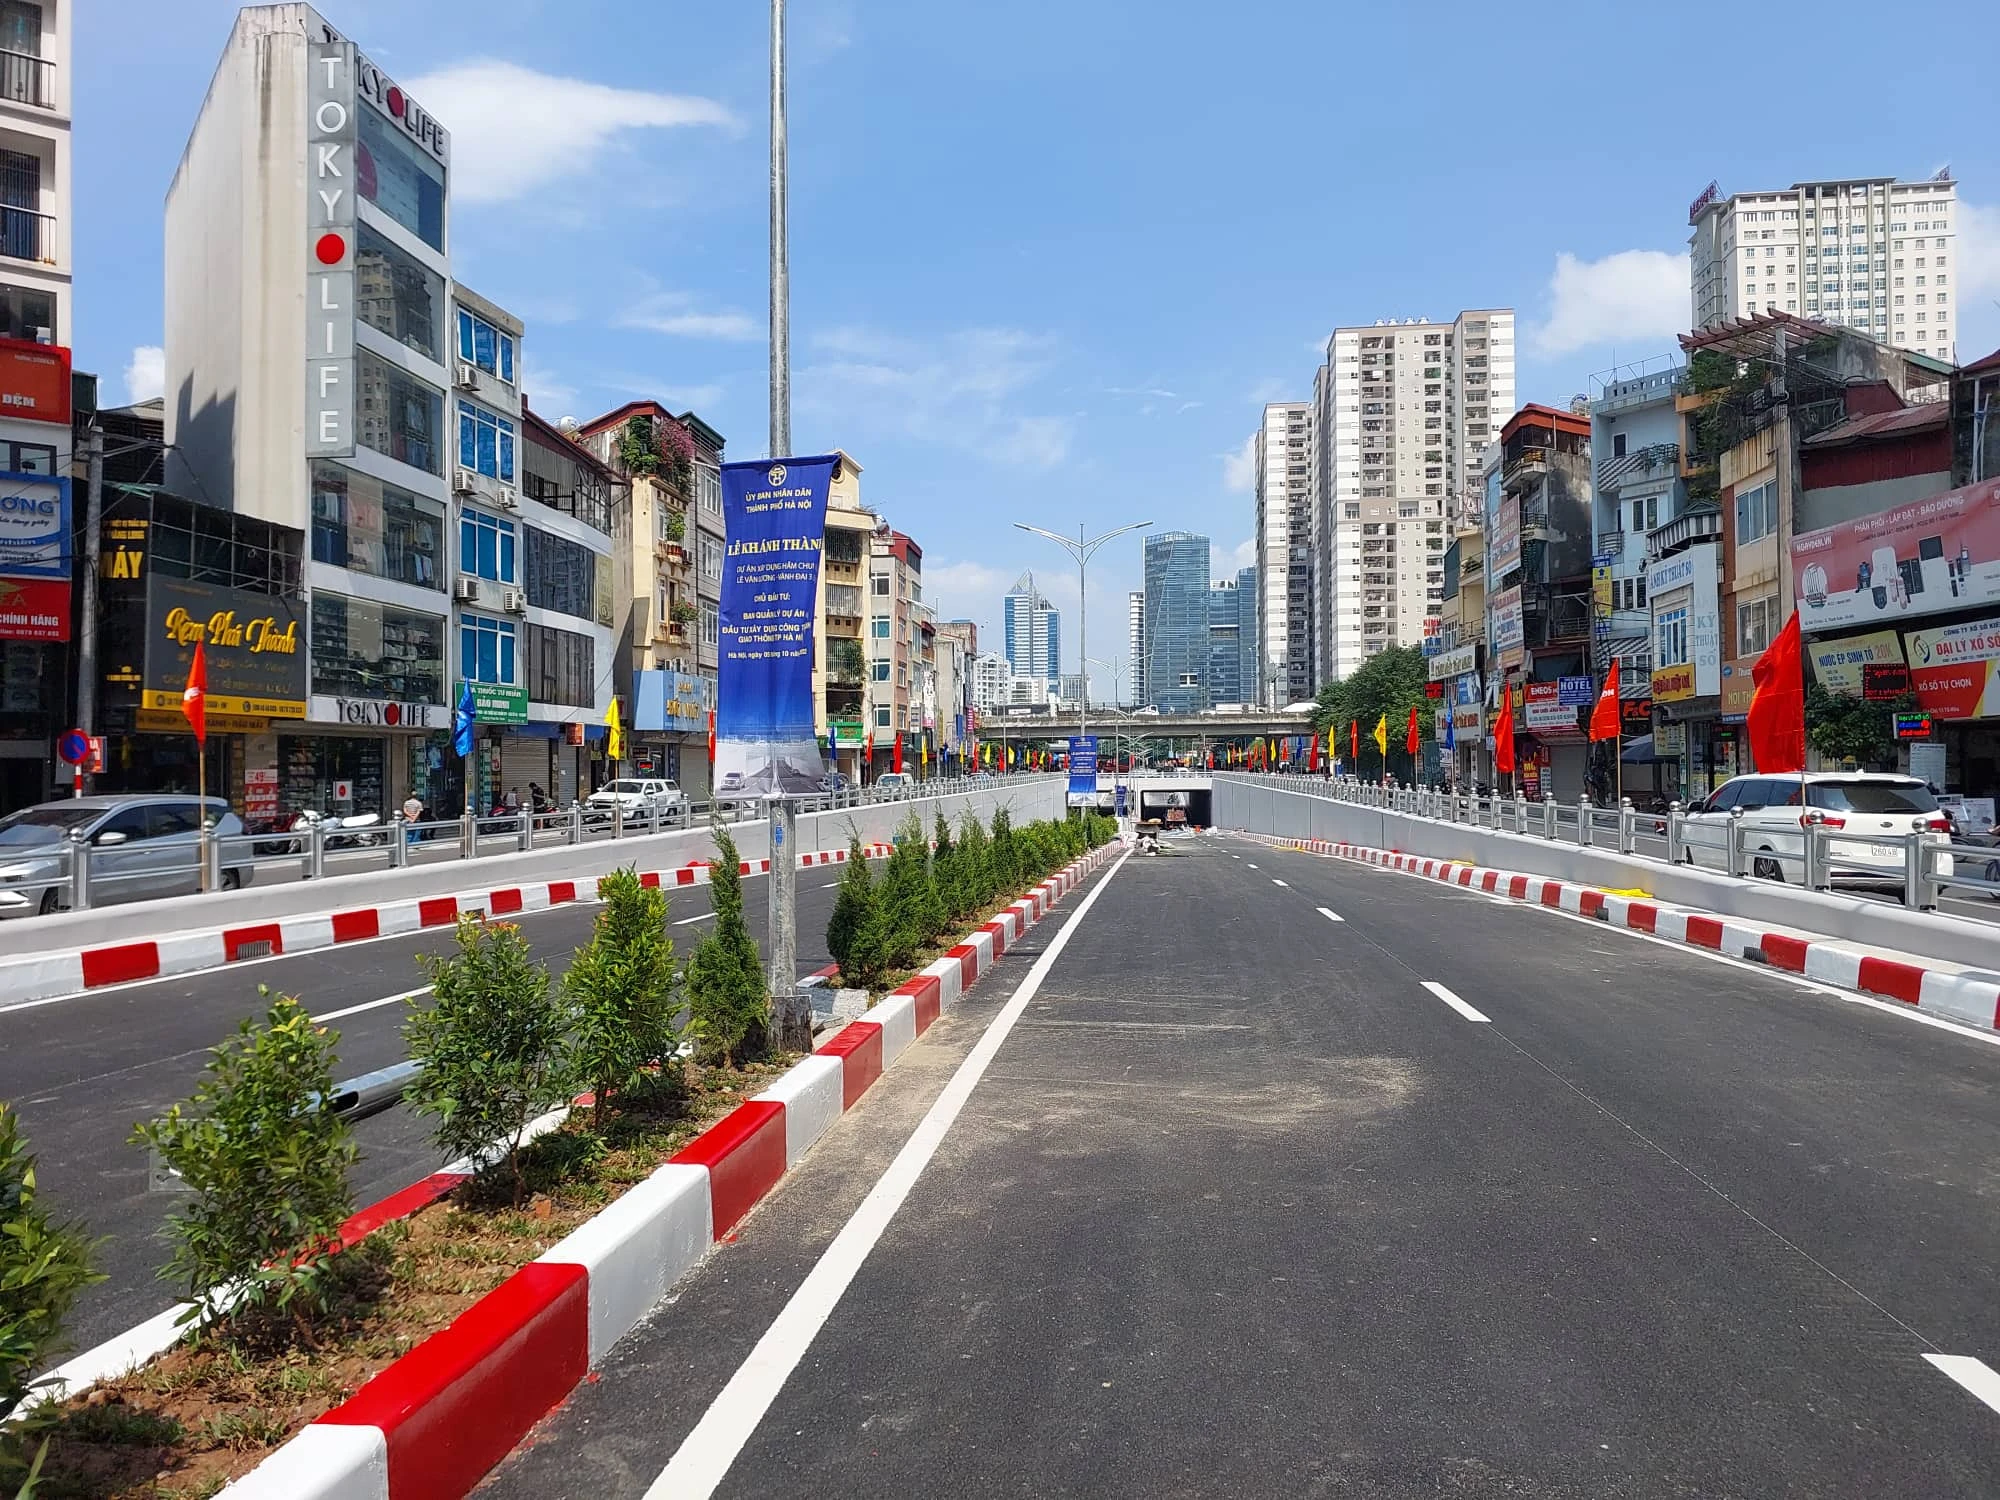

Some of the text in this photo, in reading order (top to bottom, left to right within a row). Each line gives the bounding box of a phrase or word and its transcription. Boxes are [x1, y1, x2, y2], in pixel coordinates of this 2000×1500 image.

[773, 488, 793, 498] NHÂN
[795, 487, 812, 497] DÂN
[785, 501, 796, 509] HÀ
[782, 535, 821, 551] THÀN
[1936, 642, 1954, 657] ĐẠI
[1955, 637, 1968, 653] LÝ
[1970, 633, 1985, 651] XỔ
[1560, 680, 1591, 690] HOTEL
